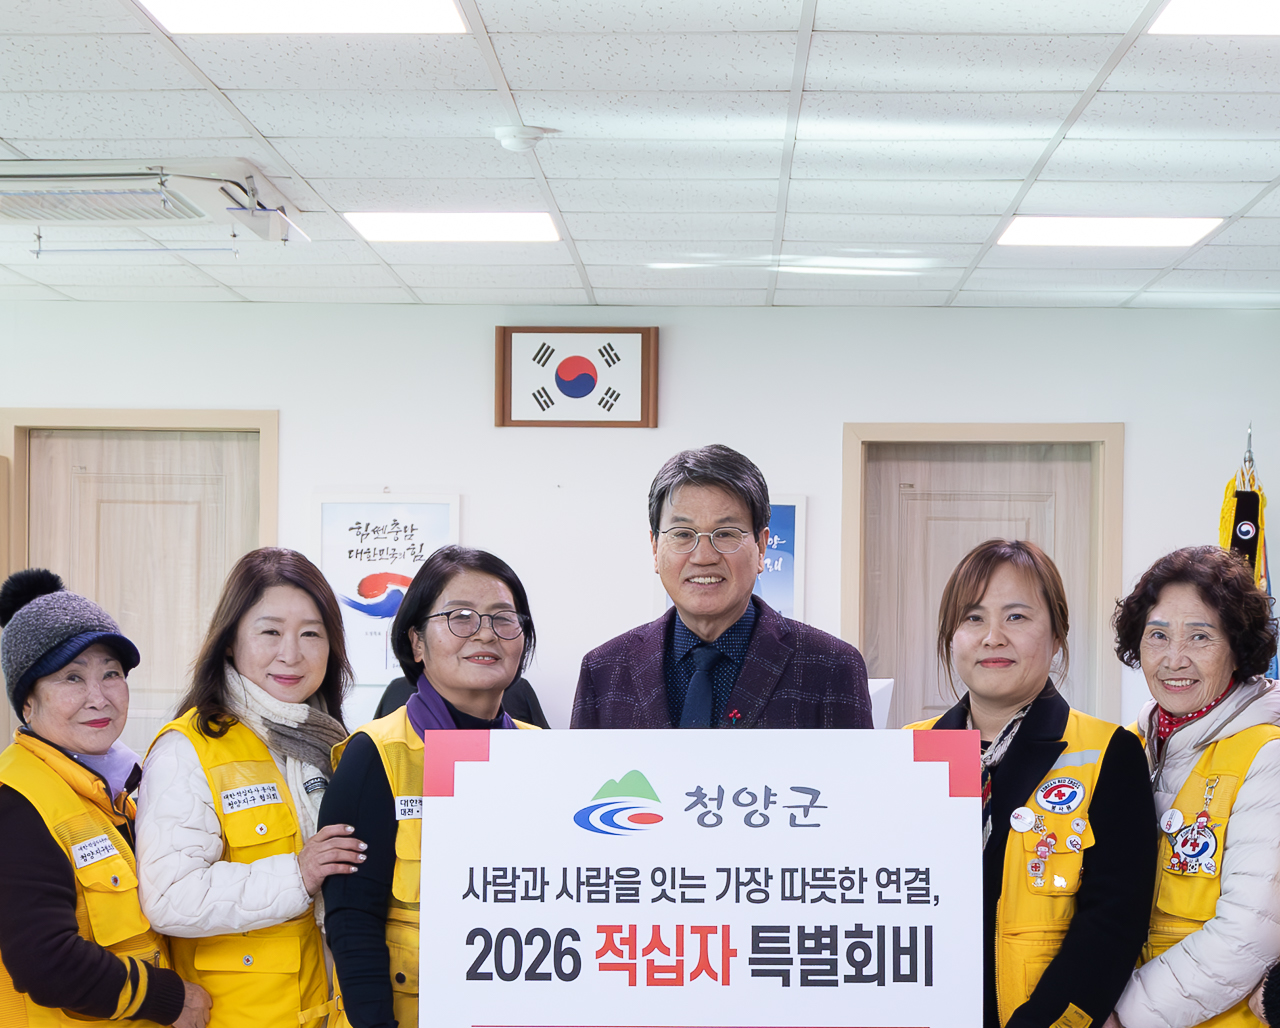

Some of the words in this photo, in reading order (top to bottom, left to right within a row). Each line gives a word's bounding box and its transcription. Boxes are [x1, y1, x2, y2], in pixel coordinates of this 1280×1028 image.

[348, 547, 406, 565] 대한민국의
[406, 542, 426, 562] 힘
[400, 808, 414, 816] 대전
[684, 784, 828, 829] 청양군
[463, 867, 549, 903] 사람과
[558, 867, 641, 903] 사람을
[651, 867, 706, 903] 잇는
[716, 867, 773, 904] 가장
[781, 867, 867, 903] 따뜻한
[876, 867, 939, 906] 연결,
[466, 928, 581, 982] 2026
[596, 925, 737, 986] 적십자
[749, 923, 933, 987] 특별회비
